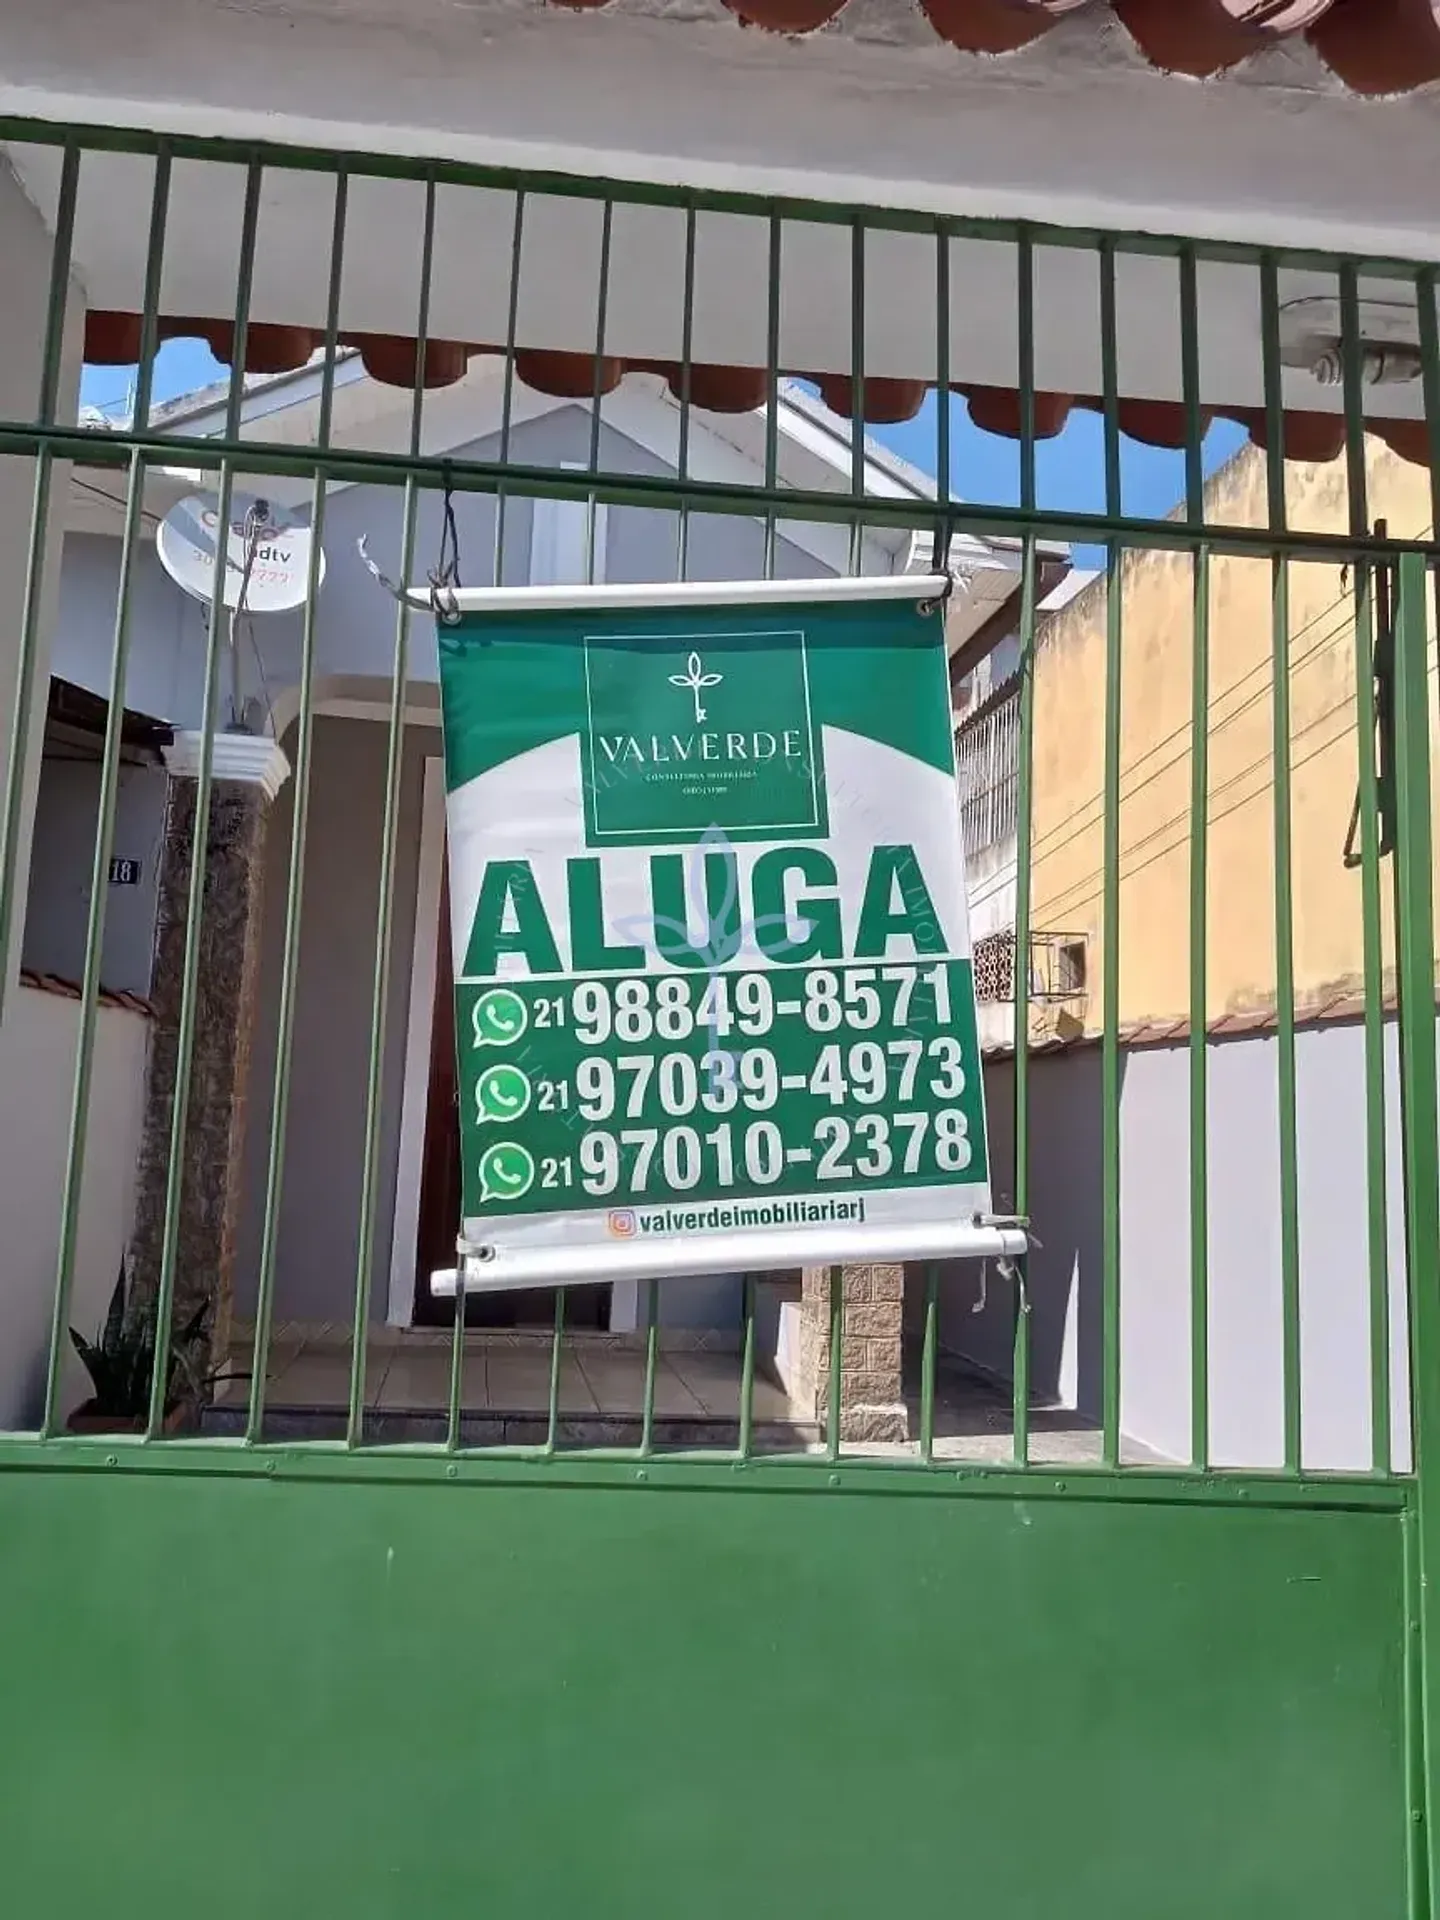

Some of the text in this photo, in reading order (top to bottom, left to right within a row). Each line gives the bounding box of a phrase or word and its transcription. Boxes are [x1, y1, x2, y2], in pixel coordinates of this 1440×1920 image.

[599, 730, 801, 762] VALVERDE
[461, 844, 950, 977] ALUGA
[534, 963, 952, 1045] 21 98849-8571
[538, 1080, 569, 1112] 21
[576, 1036, 966, 1121] 97039-4973
[541, 1156, 572, 1188] 21
[579, 1108, 972, 1196] 97010-2378
[640, 1197, 866, 1234] valverdeimobiliariarj
